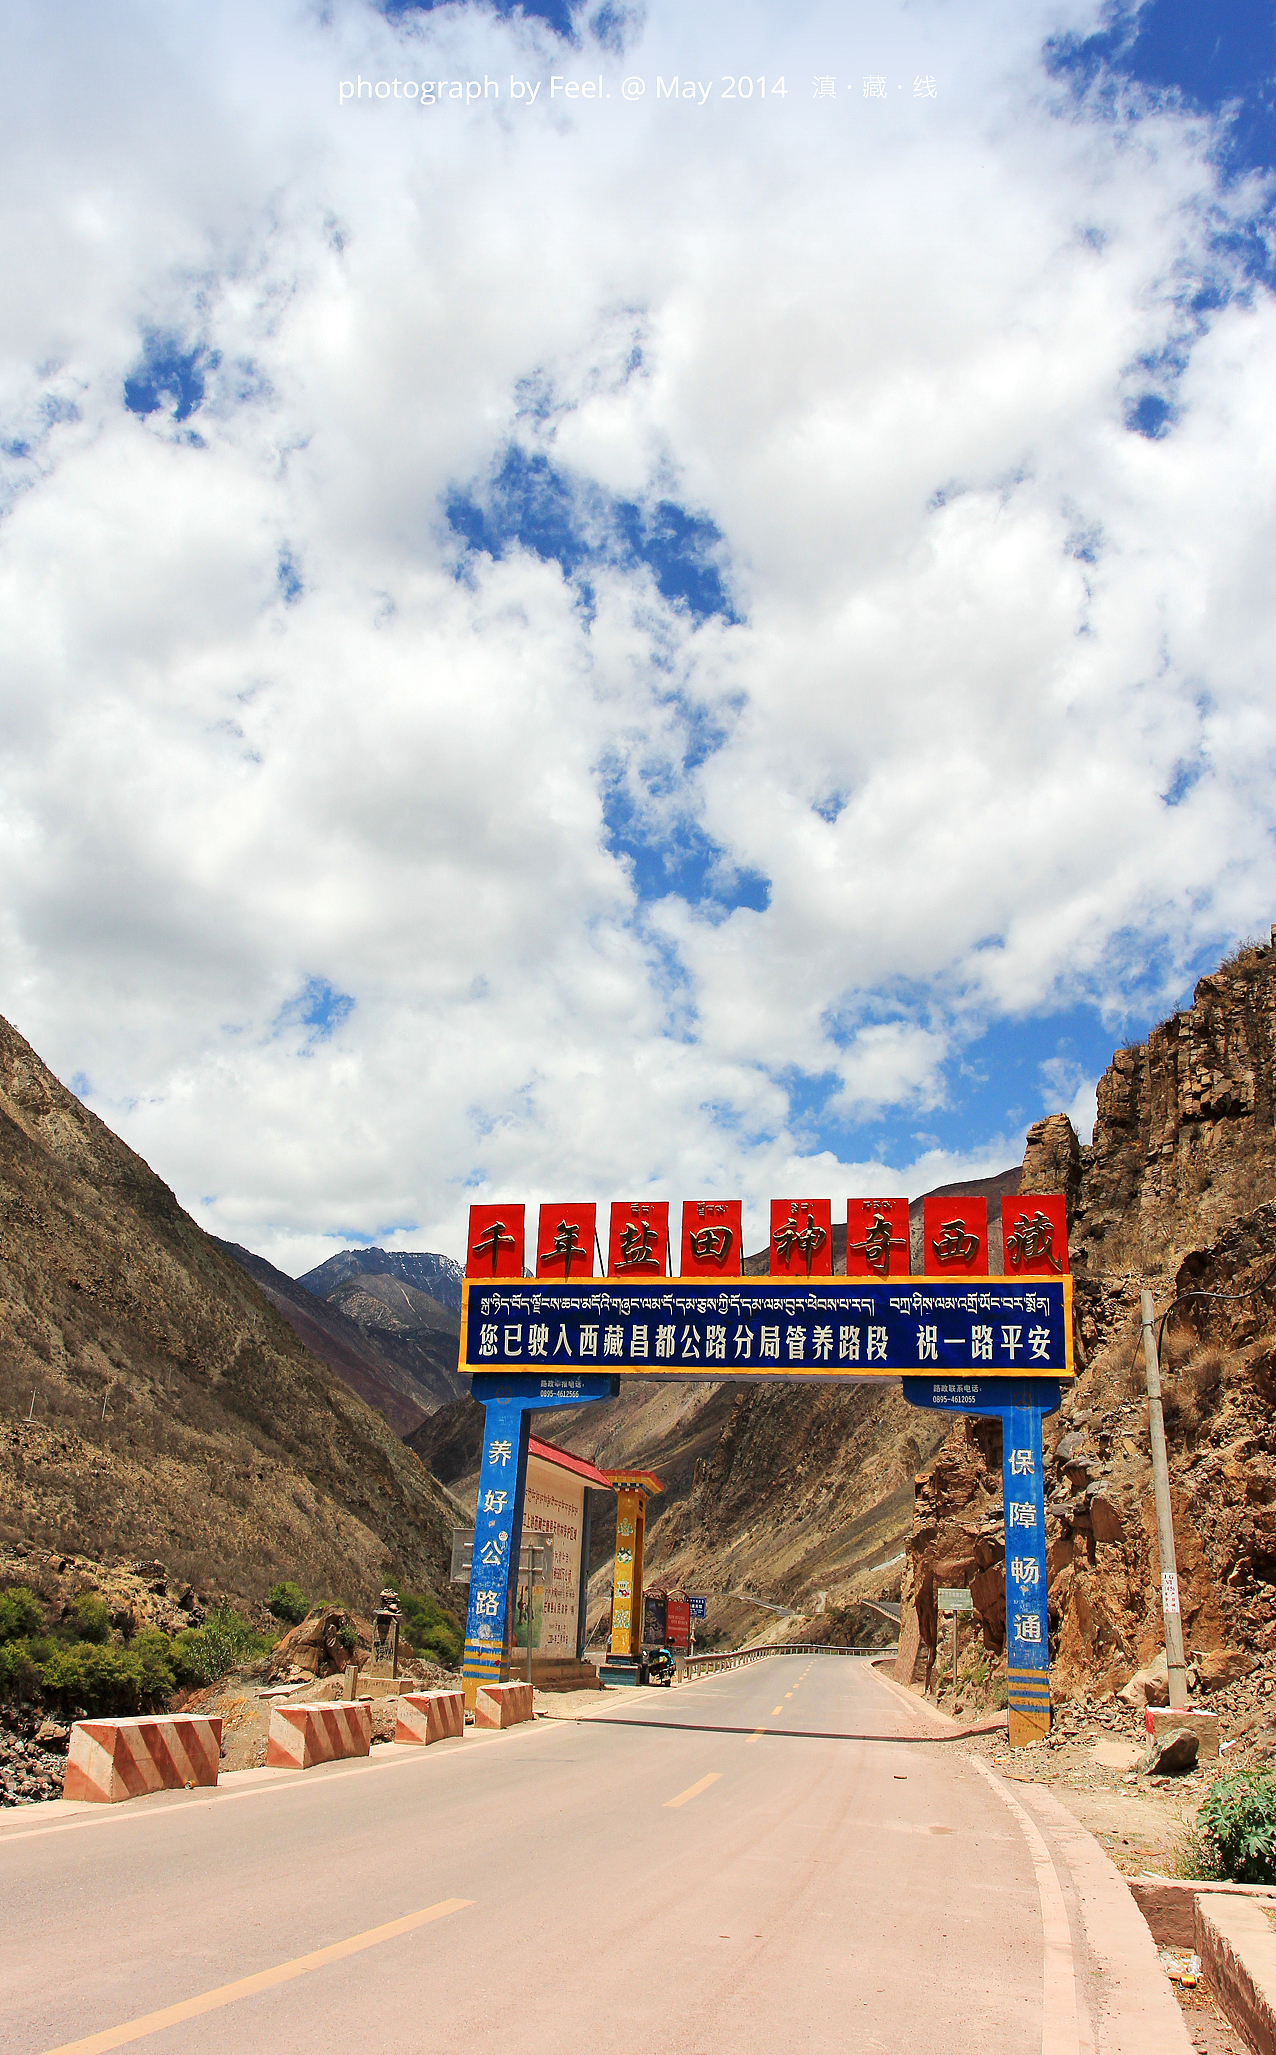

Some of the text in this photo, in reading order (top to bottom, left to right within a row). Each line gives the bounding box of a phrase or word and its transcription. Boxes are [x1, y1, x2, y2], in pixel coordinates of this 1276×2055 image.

[472, 1211, 1062, 1278] 千年盐田 神奇西藏
[478, 1323, 1051, 1361] 您已驶入西藏昌都公路分局管养路段 祝一路平安
[932, 1395, 976, 1404] 0895-4612055
[475, 1440, 512, 1617] 养好公路
[1008, 1449, 1042, 1643] 保障畅通
